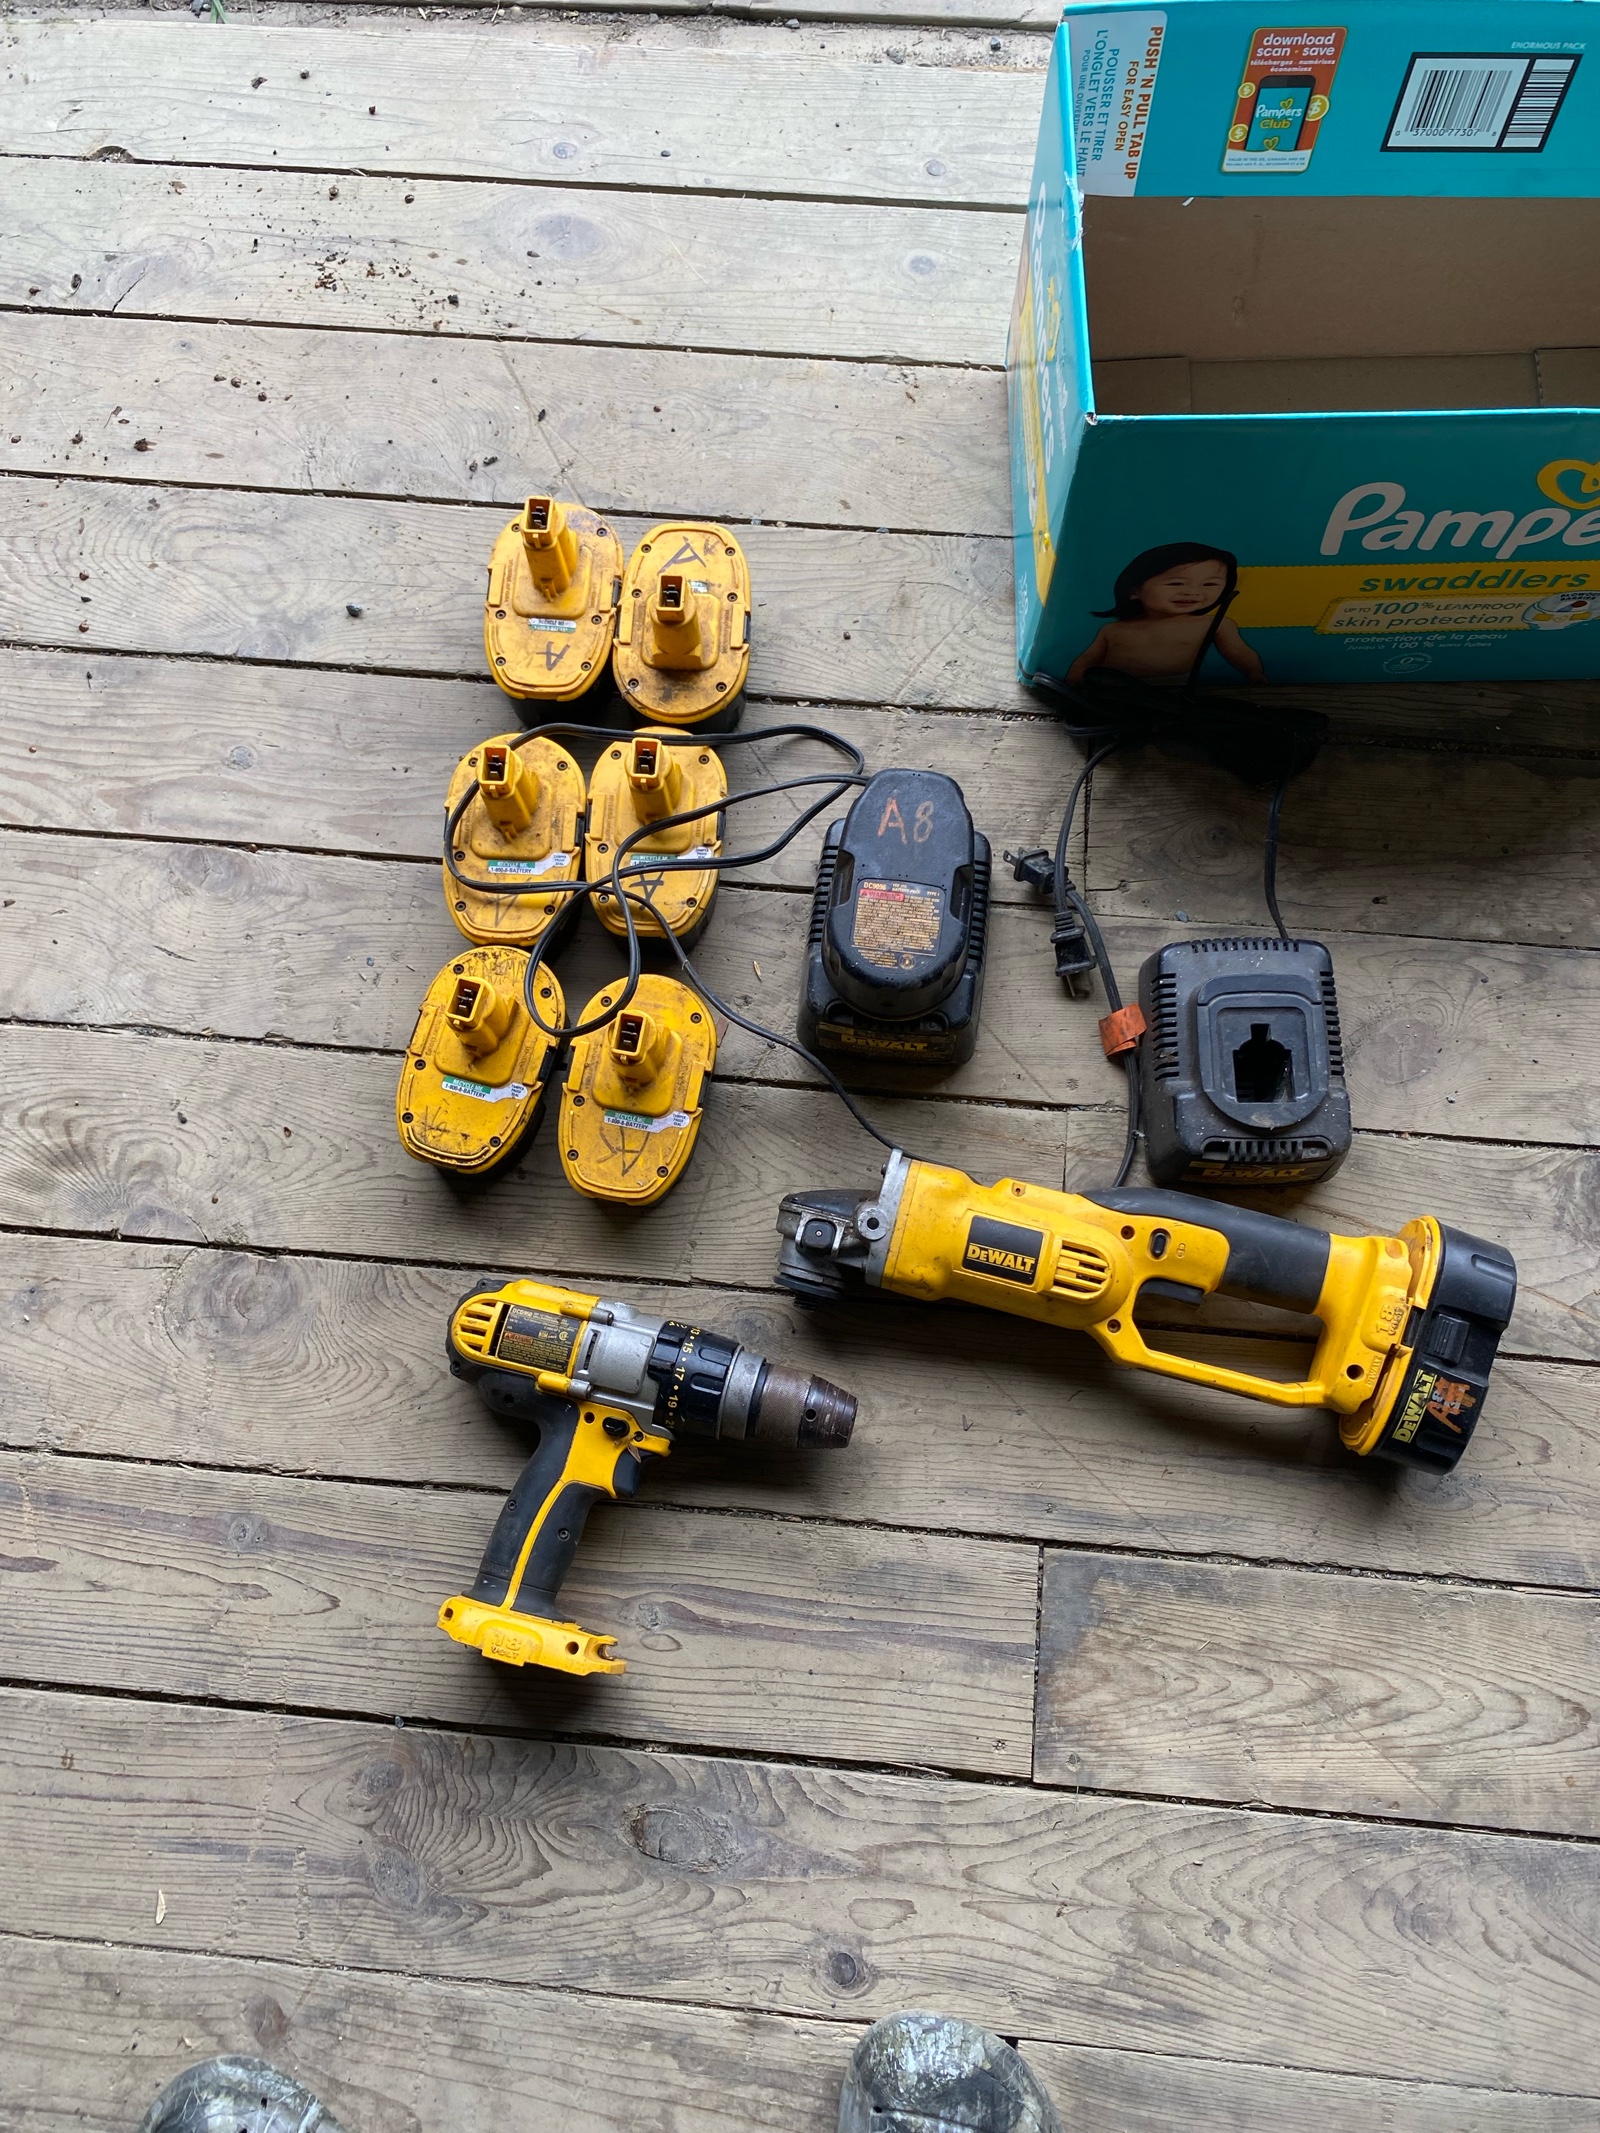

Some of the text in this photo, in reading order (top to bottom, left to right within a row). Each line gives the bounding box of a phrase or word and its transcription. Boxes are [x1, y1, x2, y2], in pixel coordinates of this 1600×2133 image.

[1263, 33, 1335, 46] download
[1511, 42, 1560, 50] ENORMOUS
[1144, 27, 1163, 69] PUSH
[1256, 46, 1335, 56] scan save
[1080, 50, 1091, 72] POUR
[1078, 76, 1086, 90] UNE
[1077, 30, 1108, 177] L'ONGLET VERS LE HAUT
[1091, 49, 1120, 161] POUSSER ET TIRER
[1114, 61, 1139, 151] FOR EASY OPEN
[1133, 94, 1151, 129] PULL
[1256, 104, 1302, 118] Pampers
[1260, 120, 1291, 129] Club
[1128, 132, 1143, 158] TAB
[1124, 162, 1138, 179] UP
[1360, 569, 1591, 592] swaddlers
[1436, 602, 1526, 612] LEAKPROOF
[1334, 614, 1514, 629] skin protection
[1344, 634, 1422, 644] protection
[1426, 634, 1446, 642] de
[1467, 634, 1508, 642] peau
[1391, 642, 1418, 650] 100
[877, 796, 934, 844] A8
[452, 1078, 475, 1090] RECYCLE
[614, 1112, 636, 1121] RECYCLE
[1376, 1304, 1394, 1334] 18
[682, 1342, 694, 1354] 15
[674, 1366, 686, 1381] 17
[668, 1395, 679, 1408] 19
